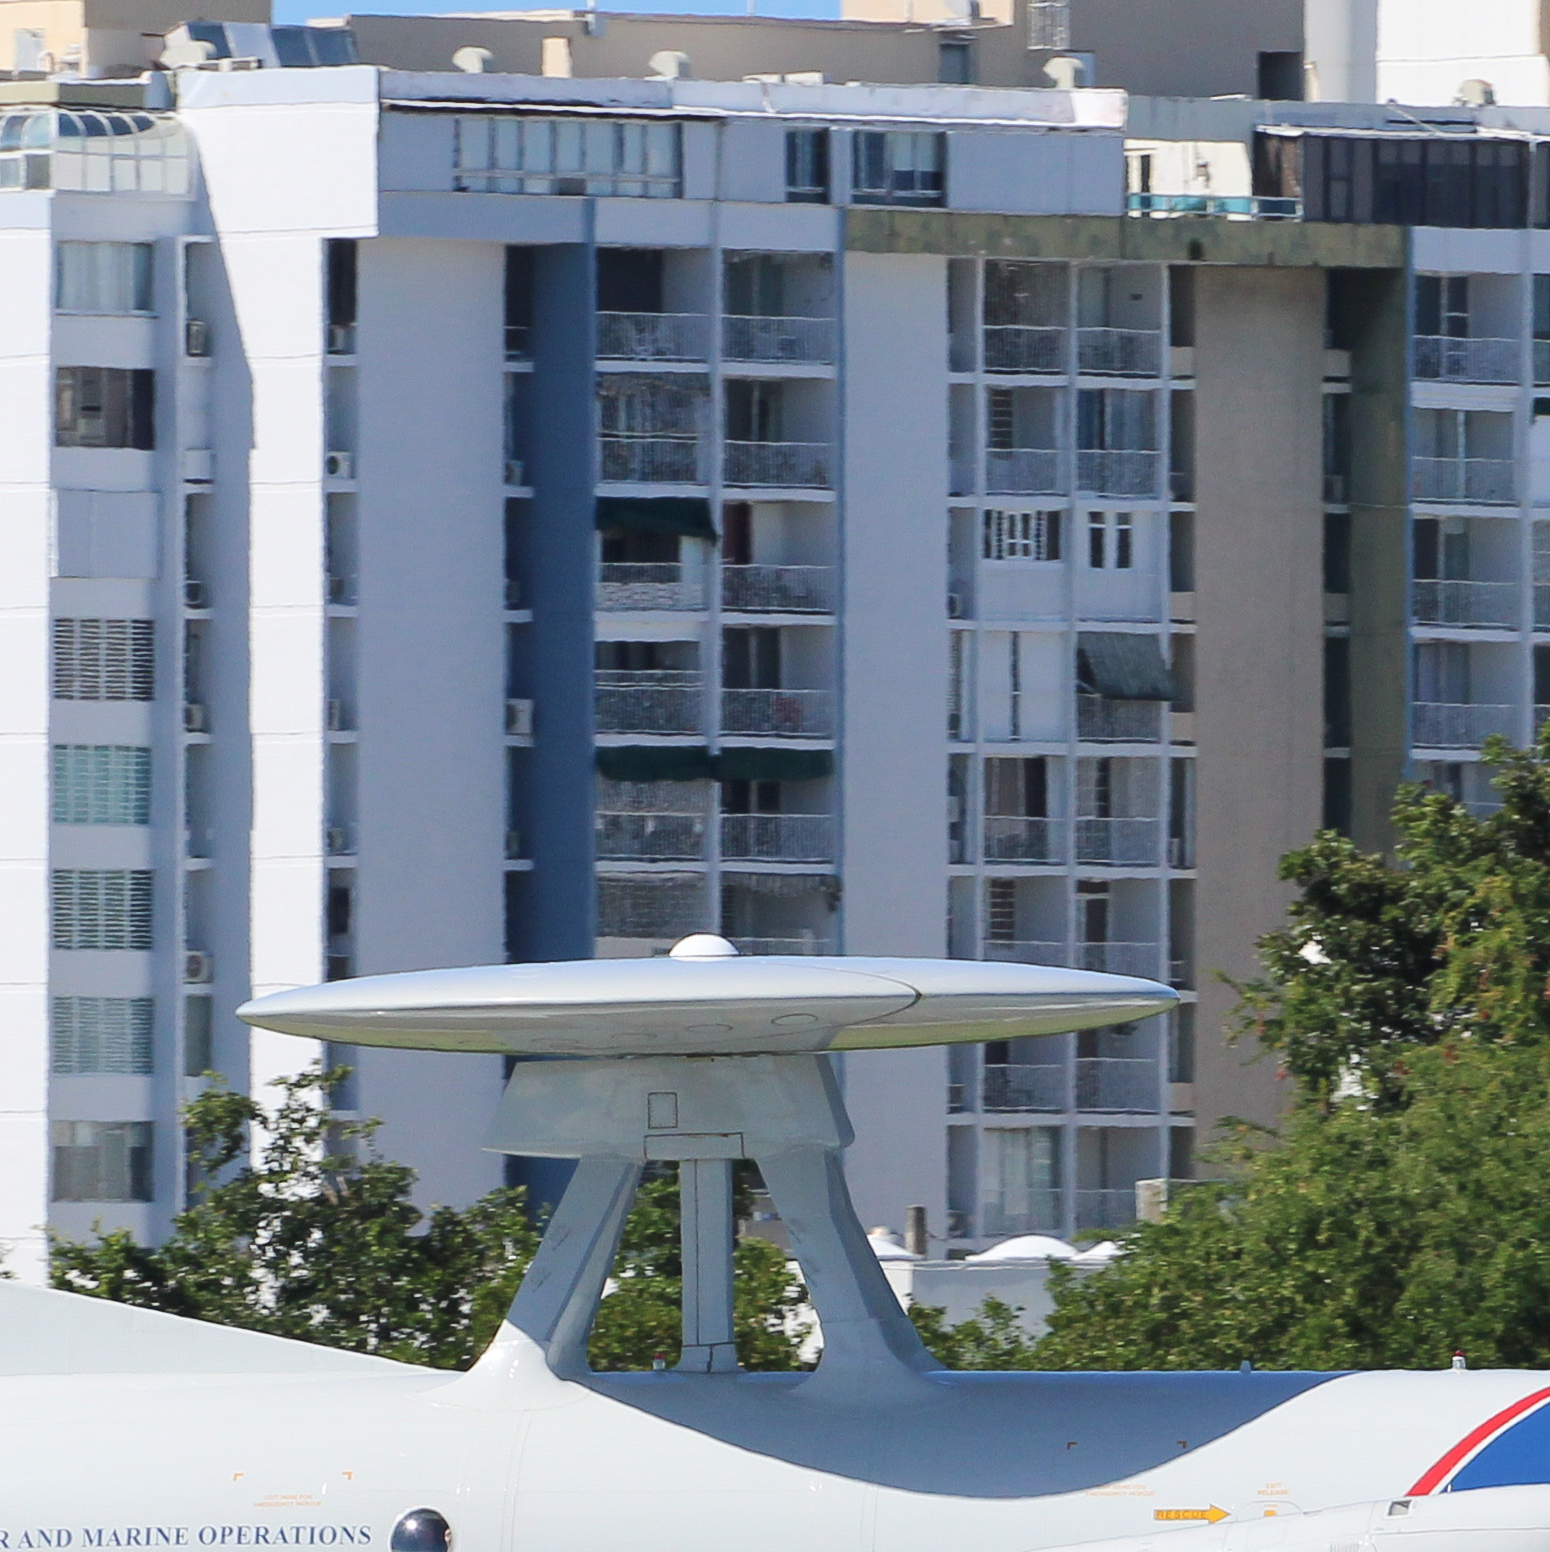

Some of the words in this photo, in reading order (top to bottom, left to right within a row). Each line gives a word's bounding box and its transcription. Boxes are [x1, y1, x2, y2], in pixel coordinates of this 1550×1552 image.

[1156, 1510, 1207, 1520] RESCUE
[17, 1528, 73, 1549] AND
[81, 1526, 189, 1548] MARINE
[197, 1524, 373, 1547] OPERATIONS
